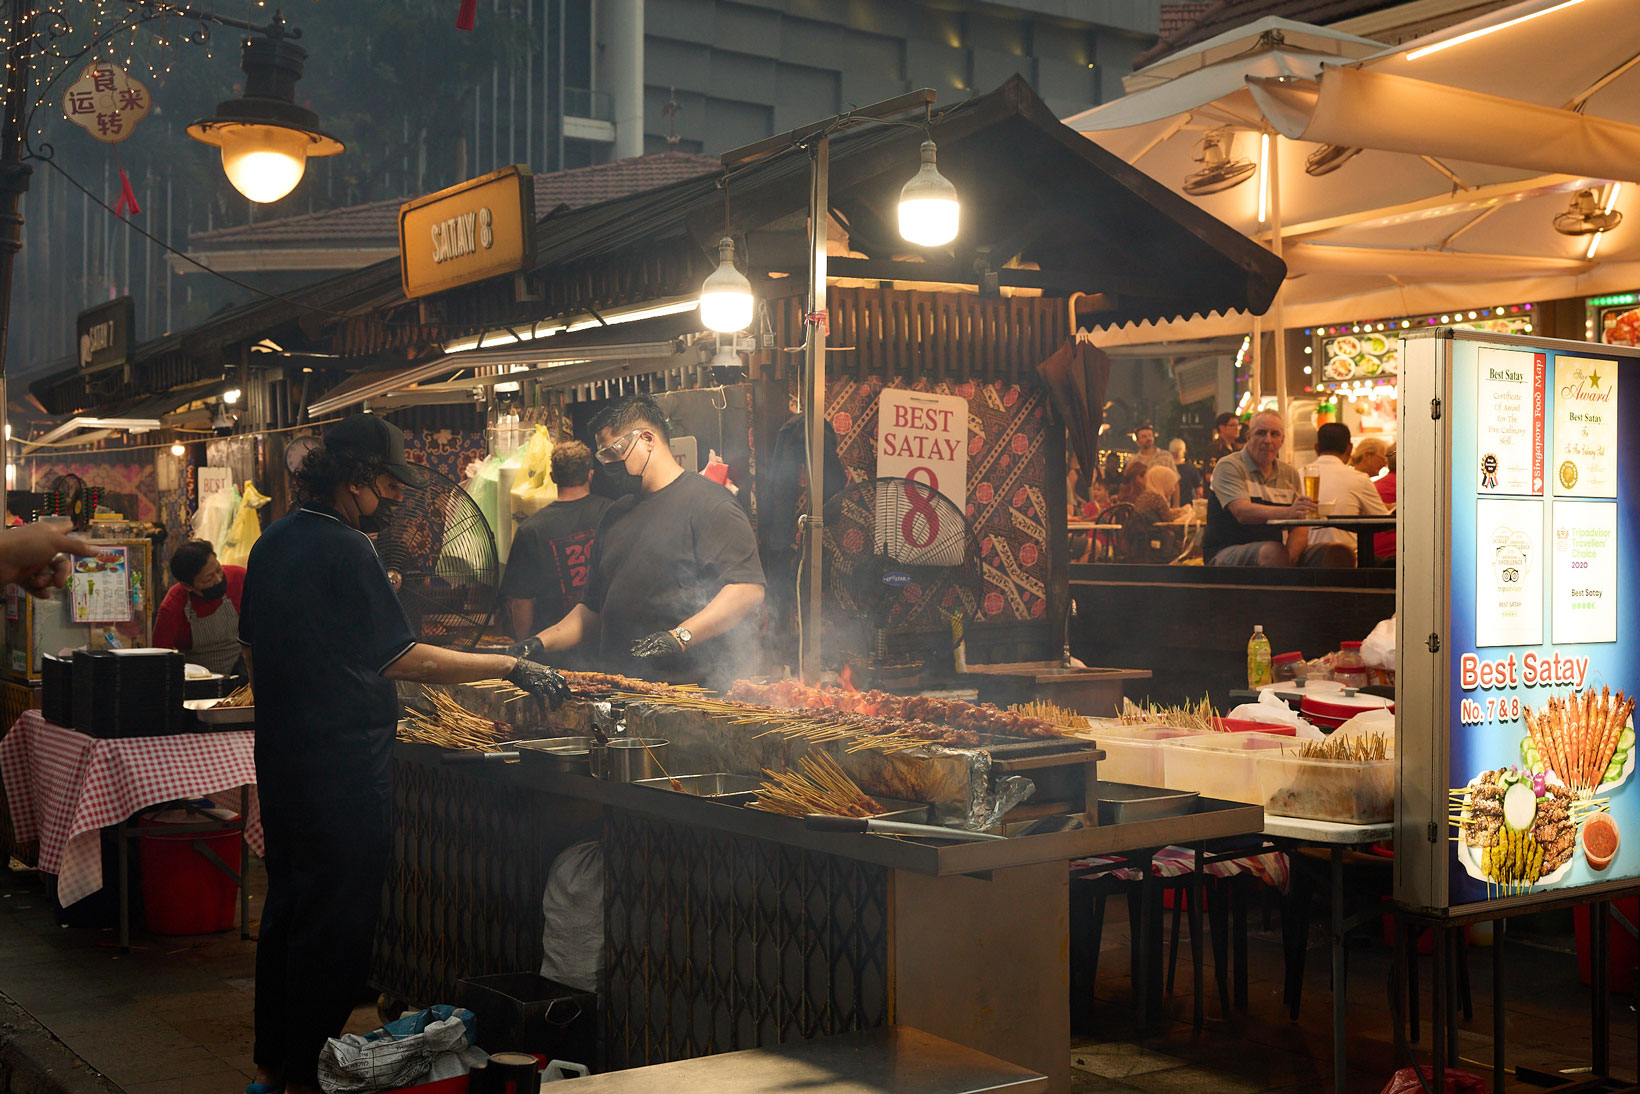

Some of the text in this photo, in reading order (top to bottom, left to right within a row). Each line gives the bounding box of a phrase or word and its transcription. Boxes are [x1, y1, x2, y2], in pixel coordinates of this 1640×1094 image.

[69, 91, 96, 115] 运
[119, 88, 145, 111] 来
[96, 111, 123, 136] 转
[431, 207, 493, 264] SATAY 8
[1489, 367, 1523, 384] Best Satay
[1534, 359, 1544, 388] Map
[1560, 380, 1613, 402] Award
[893, 405, 954, 432] BEST
[1569, 411, 1602, 425] Best Satay
[883, 433, 961, 461] SATAY
[1533, 421, 1543, 477] Singapore
[203, 478, 225, 493] BEST
[902, 466, 940, 549] 8
[1571, 528, 1611, 538] Tripadvisor
[1571, 549, 1597, 558] Choice
[1571, 588, 1603, 599] Best Satay
[1461, 652, 1589, 688] Best Satay
[1462, 698, 1519, 721] No. 7 & 8
